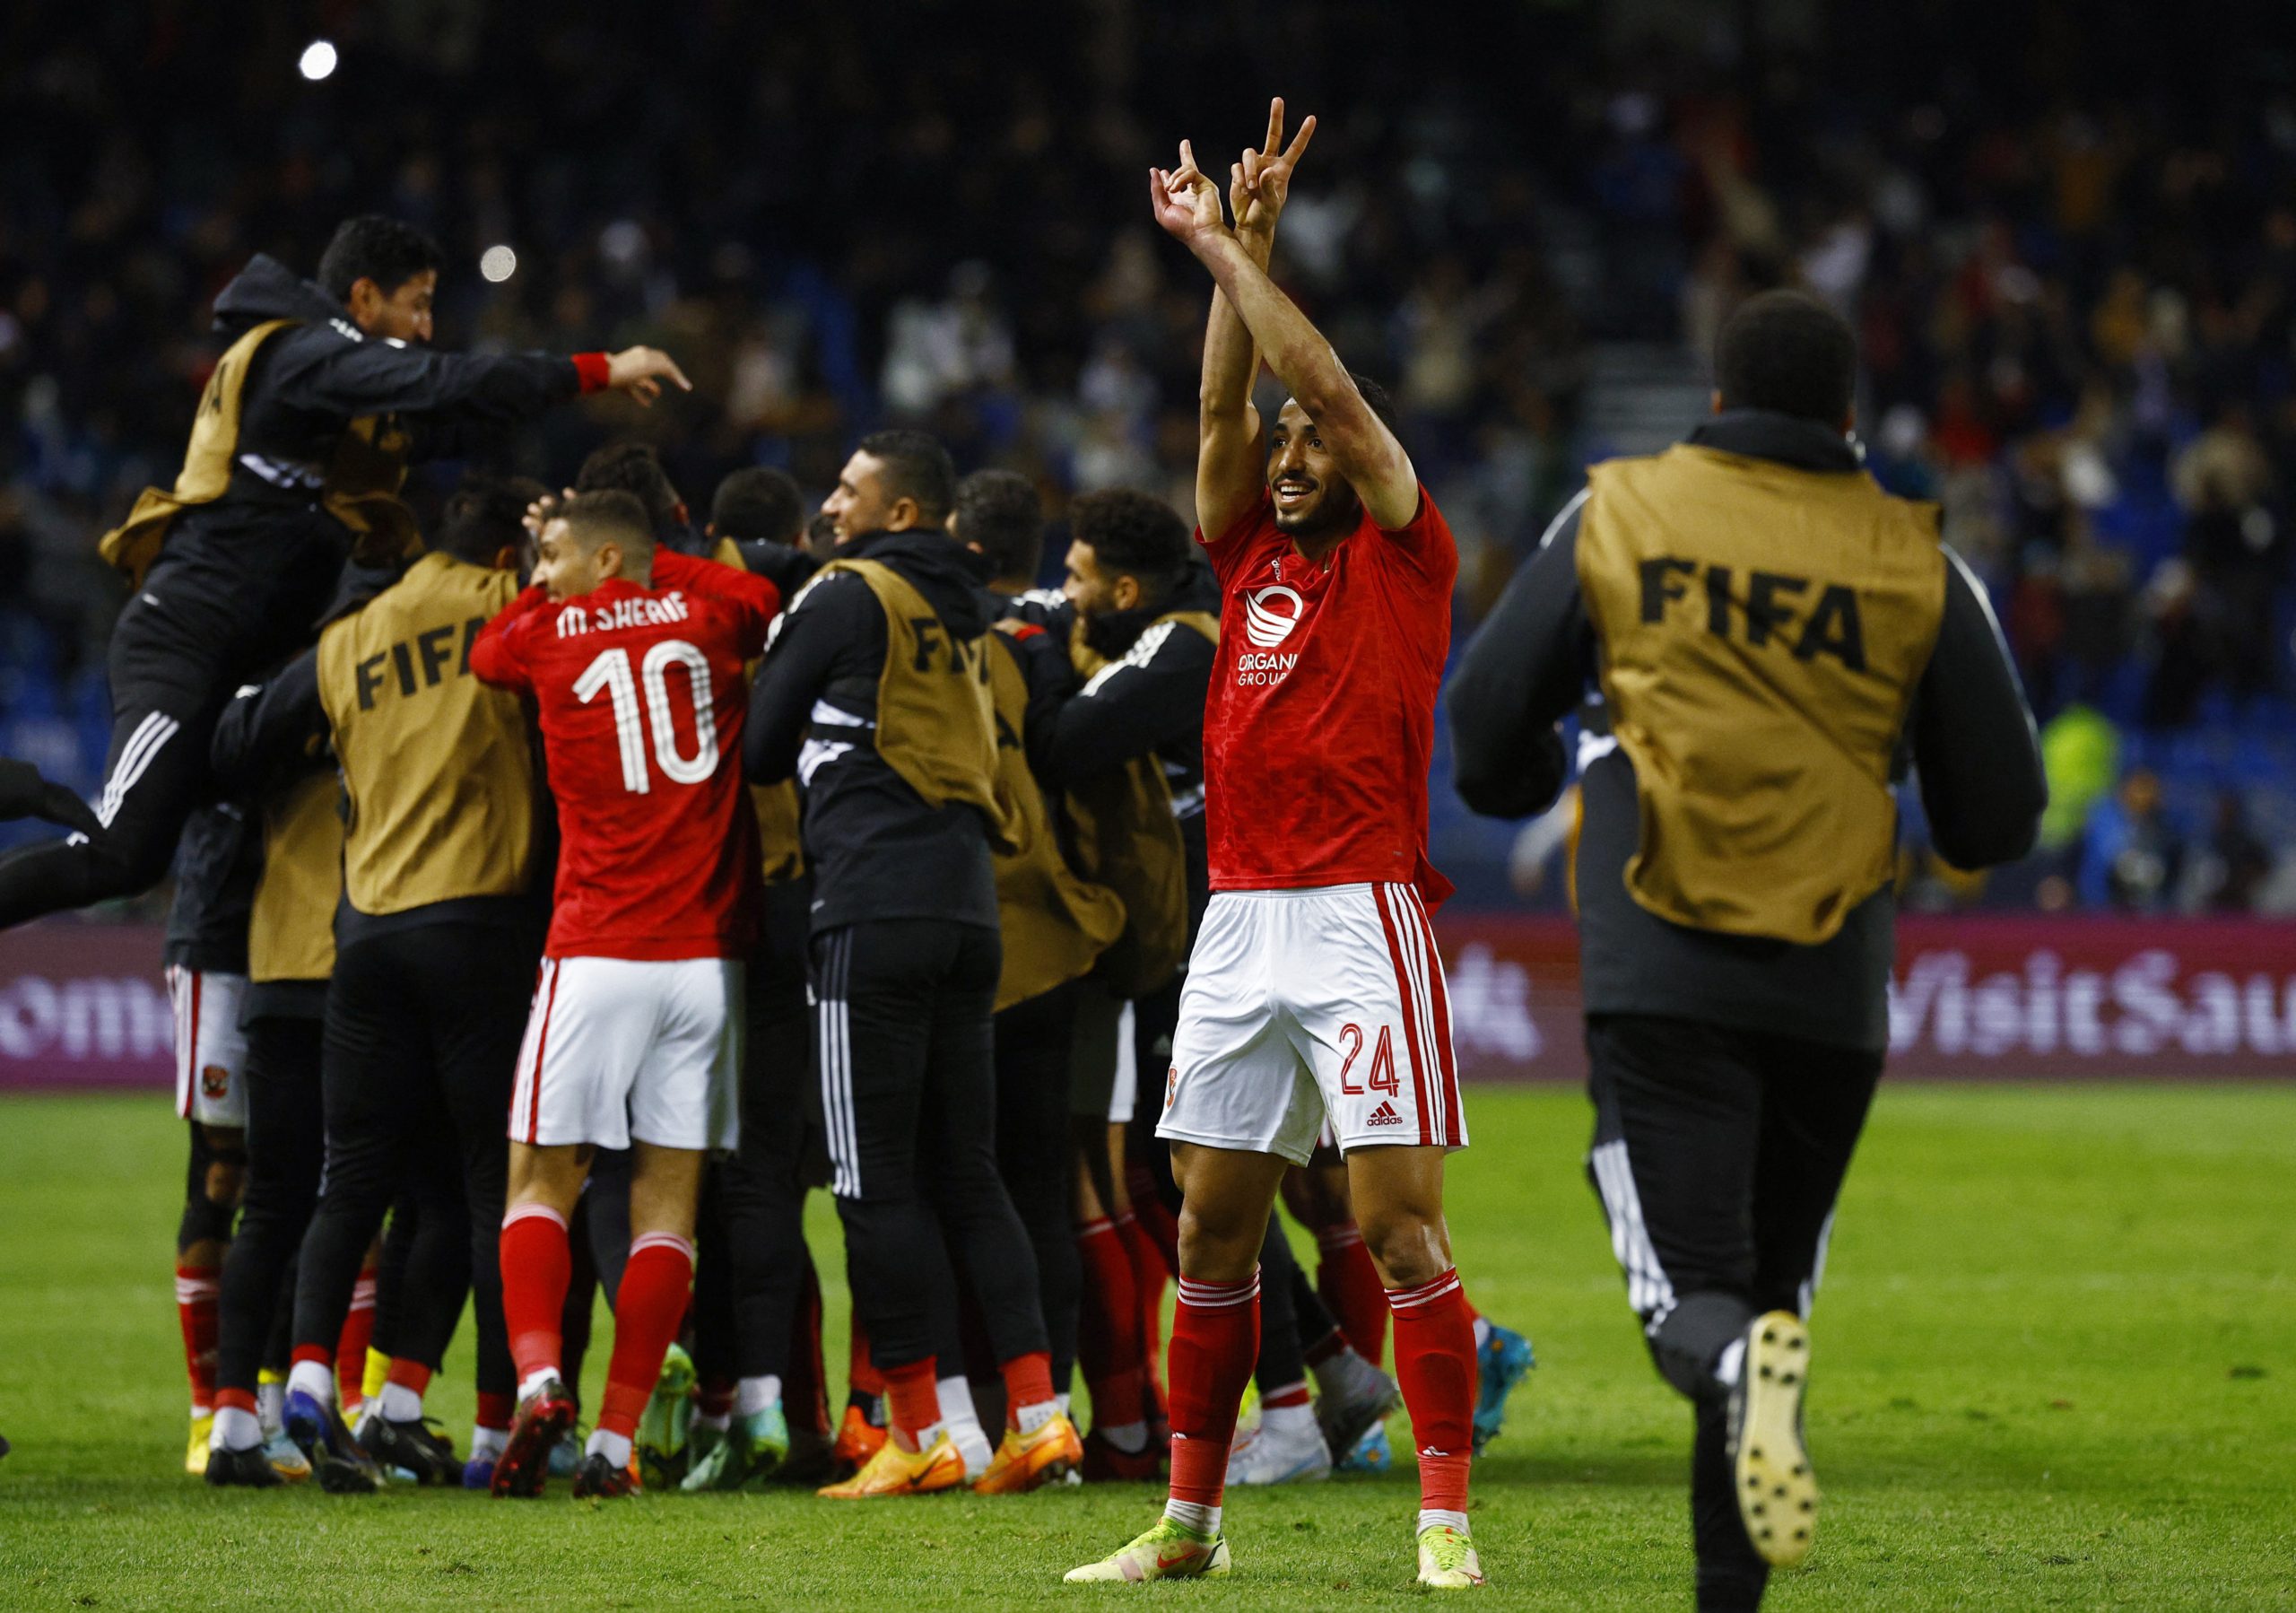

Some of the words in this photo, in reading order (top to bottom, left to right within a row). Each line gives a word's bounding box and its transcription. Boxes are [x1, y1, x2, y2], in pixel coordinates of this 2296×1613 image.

[1639, 556, 1866, 670] FIFA
[571, 639, 719, 795] 10
[1338, 1023, 1401, 1098] 24
[1366, 1116, 1404, 1127] adidas
